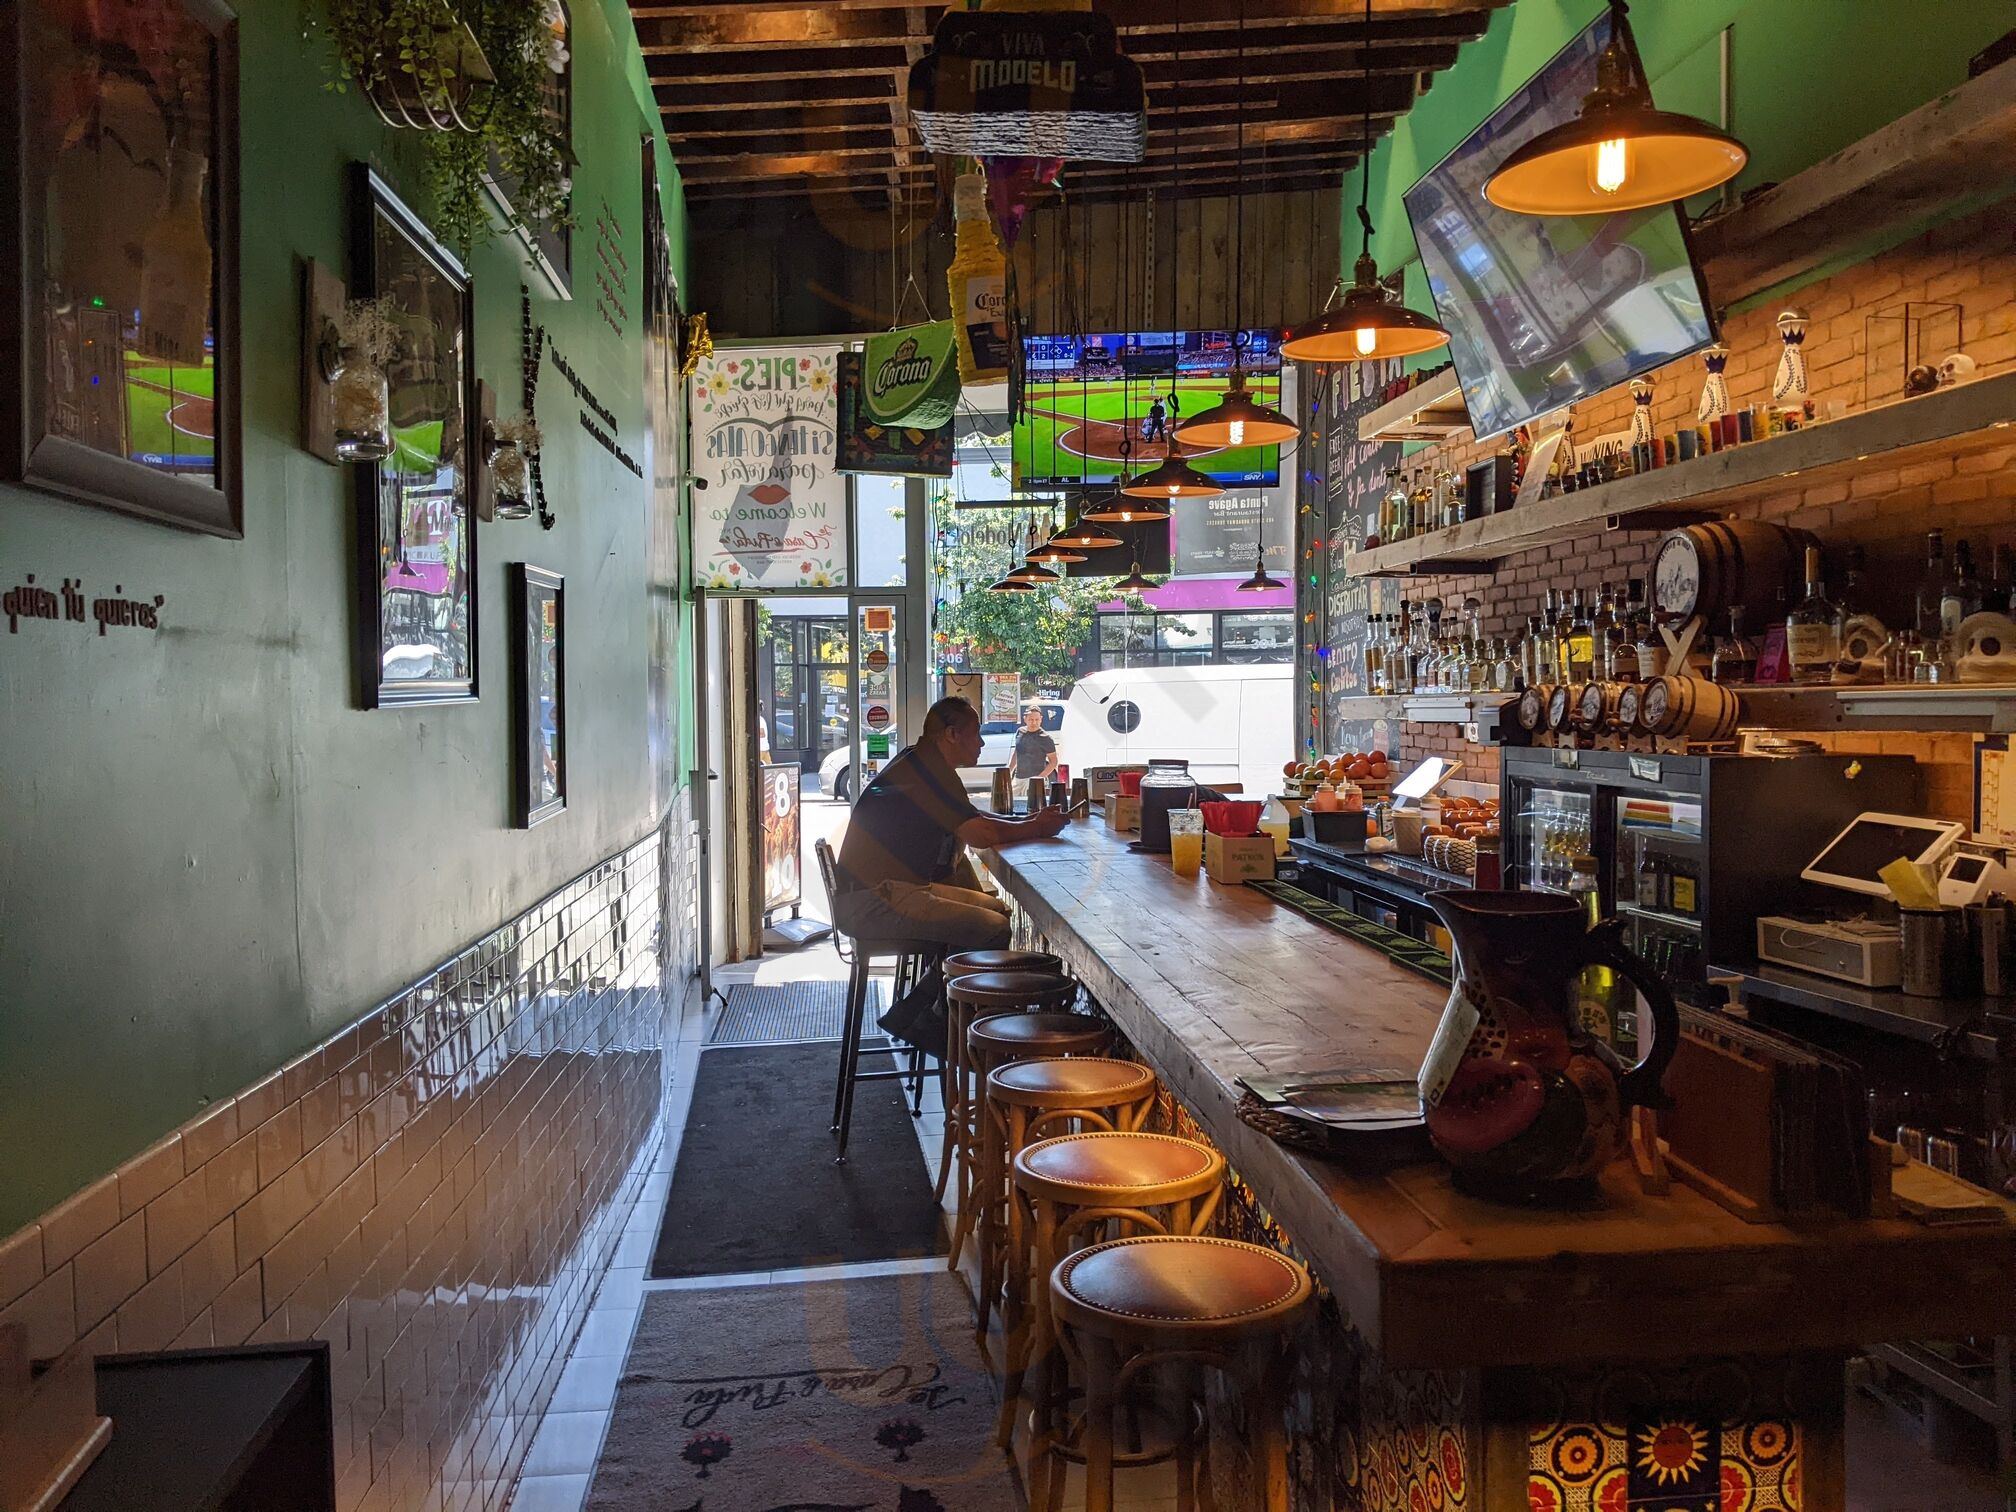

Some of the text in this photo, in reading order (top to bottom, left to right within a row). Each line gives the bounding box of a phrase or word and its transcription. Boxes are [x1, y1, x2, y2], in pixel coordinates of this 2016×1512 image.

[1001, 31, 1045, 56] VIVA
[969, 59, 1076, 94] MODELO
[875, 358, 931, 398] Corona
[938, 652, 964, 665] 306
